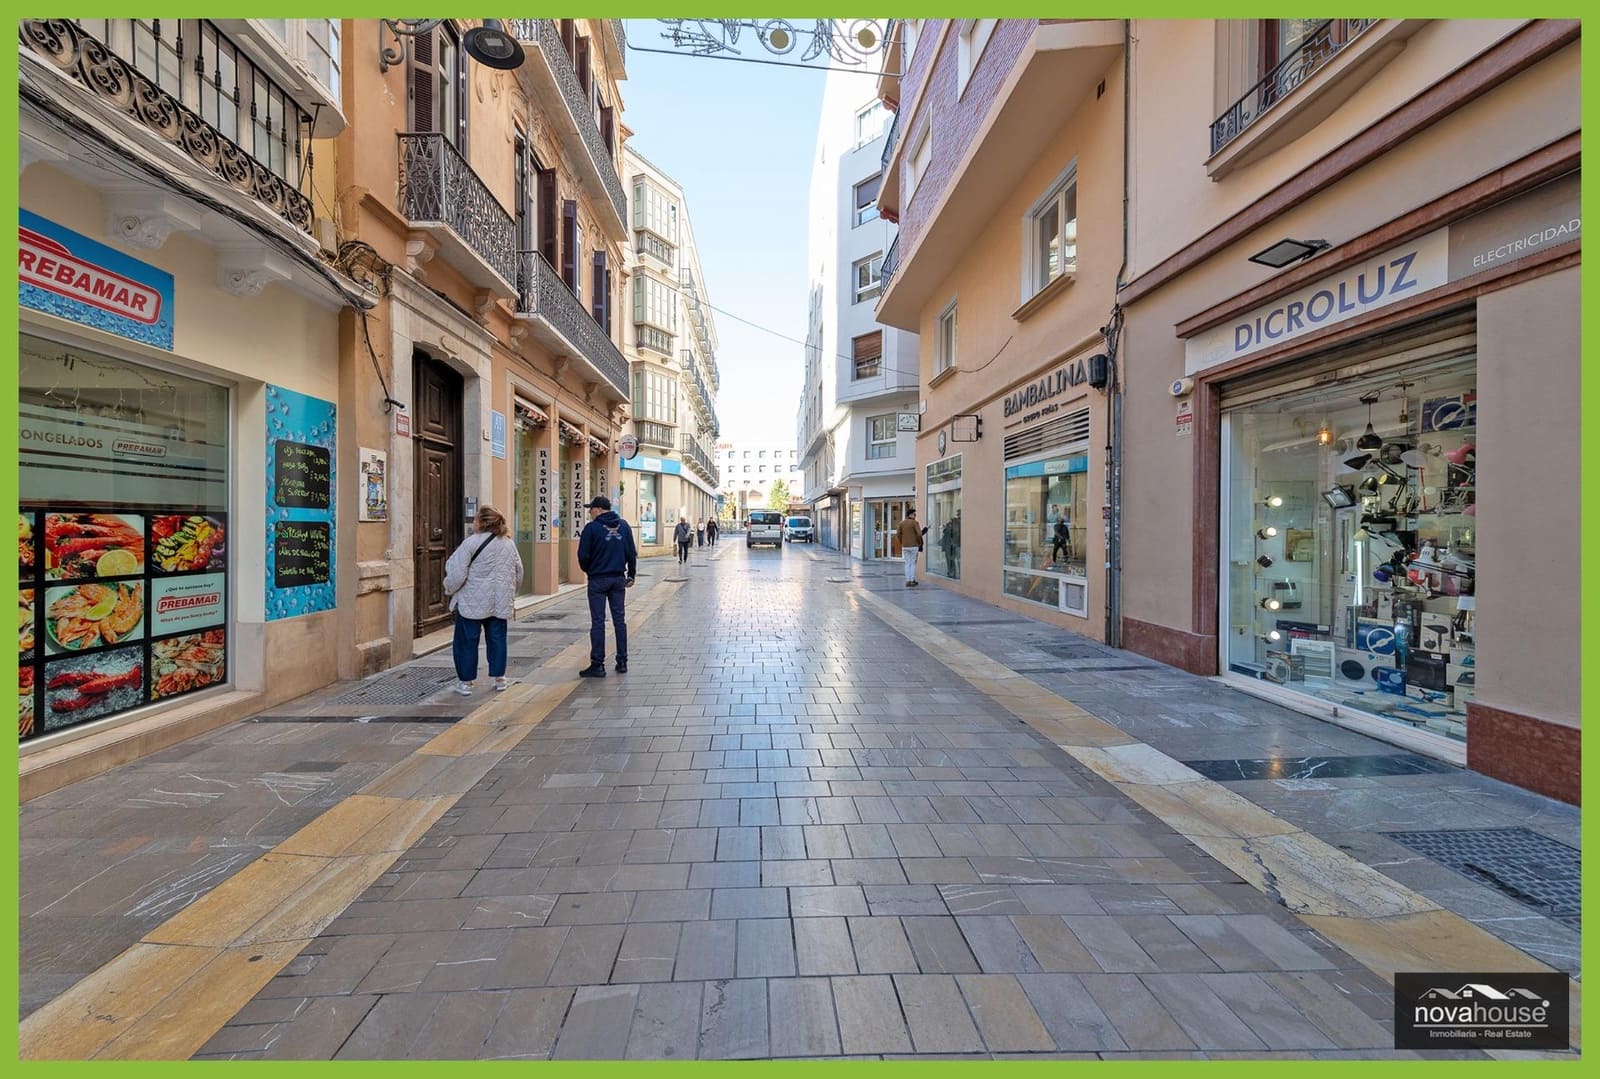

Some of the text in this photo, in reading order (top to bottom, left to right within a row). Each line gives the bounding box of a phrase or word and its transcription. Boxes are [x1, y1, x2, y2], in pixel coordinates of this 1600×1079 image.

[1473, 219, 1581, 267] ELECTRICIDAD
[19, 248, 148, 312] REBAMAR
[1234, 251, 1418, 352] DICROLUZ
[1004, 359, 1088, 418] BAMBALINA
[19, 429, 104, 449] ONGELADOS
[539, 450, 547, 540] RISTORANTE
[573, 463, 582, 538] PIZZERIA
[160, 595, 218, 610] PREBAMAR
